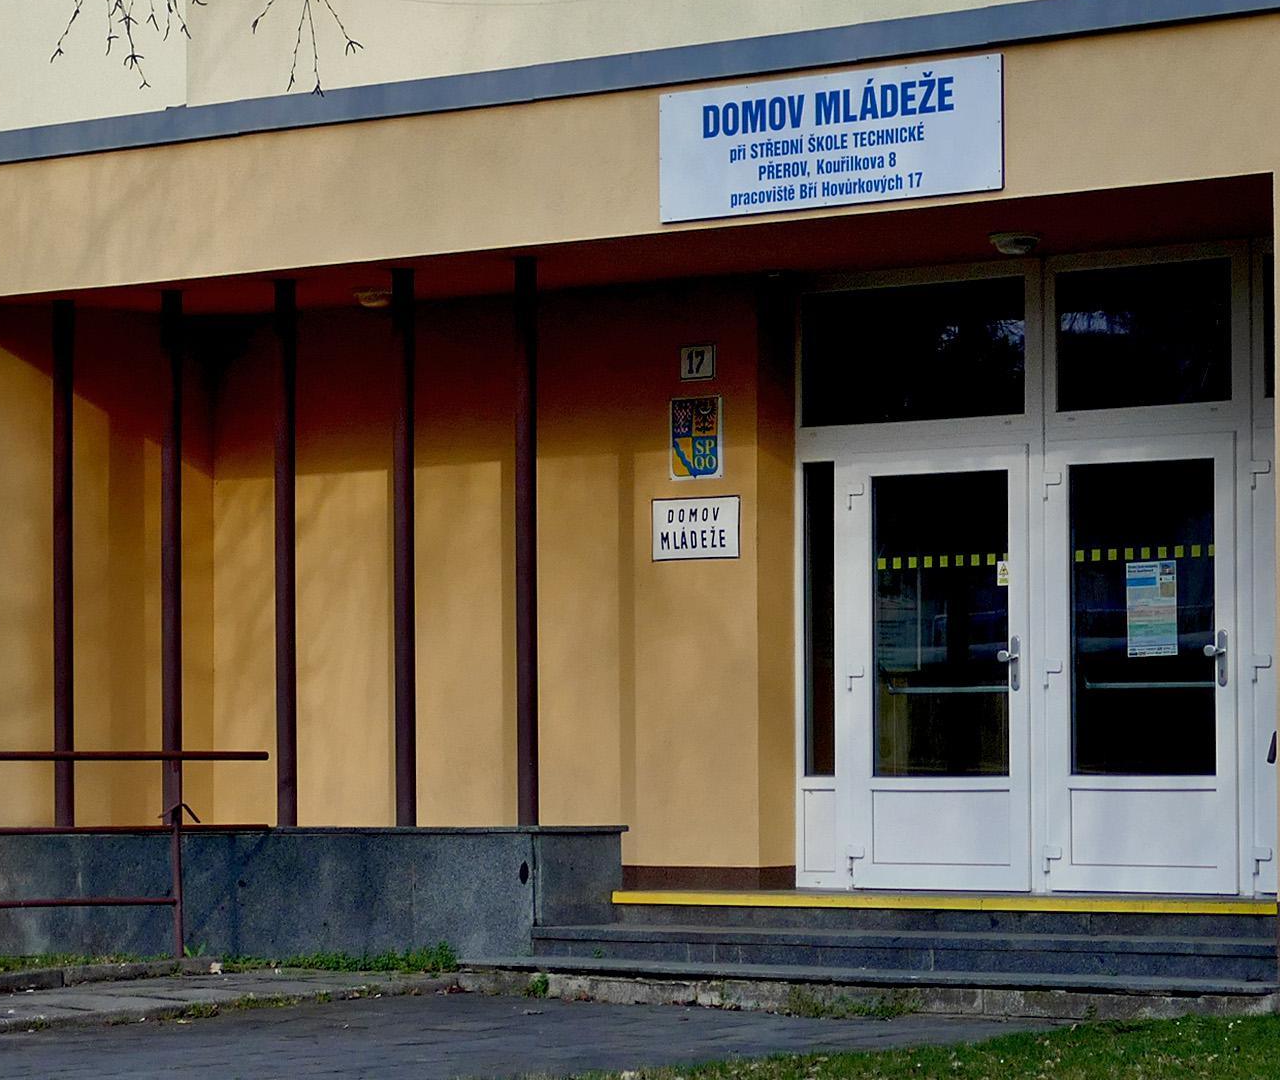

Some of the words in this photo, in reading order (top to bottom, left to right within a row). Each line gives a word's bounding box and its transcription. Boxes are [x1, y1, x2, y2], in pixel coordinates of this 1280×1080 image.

[703, 94, 805, 138] DOMOV
[815, 72, 954, 126] MLÁDEŽE
[730, 144, 746, 163] při
[750, 134, 803, 159] STŘEDNÍ
[808, 133, 848, 153] ŠKOLE
[853, 122, 924, 148] TECHNICKÉ
[758, 160, 810, 181] PŘEROV,
[816, 155, 884, 175] Kouřilkova
[888, 153, 897, 168] 8
[730, 184, 795, 208] pracoviště
[800, 182, 817, 199] Bří
[907, 172, 923, 189] 17
[686, 349, 705, 375] 17
[695, 439, 715, 455] SP
[667, 507, 720, 524] DOMOV
[660, 527, 726, 550] MLÁDEŽE
